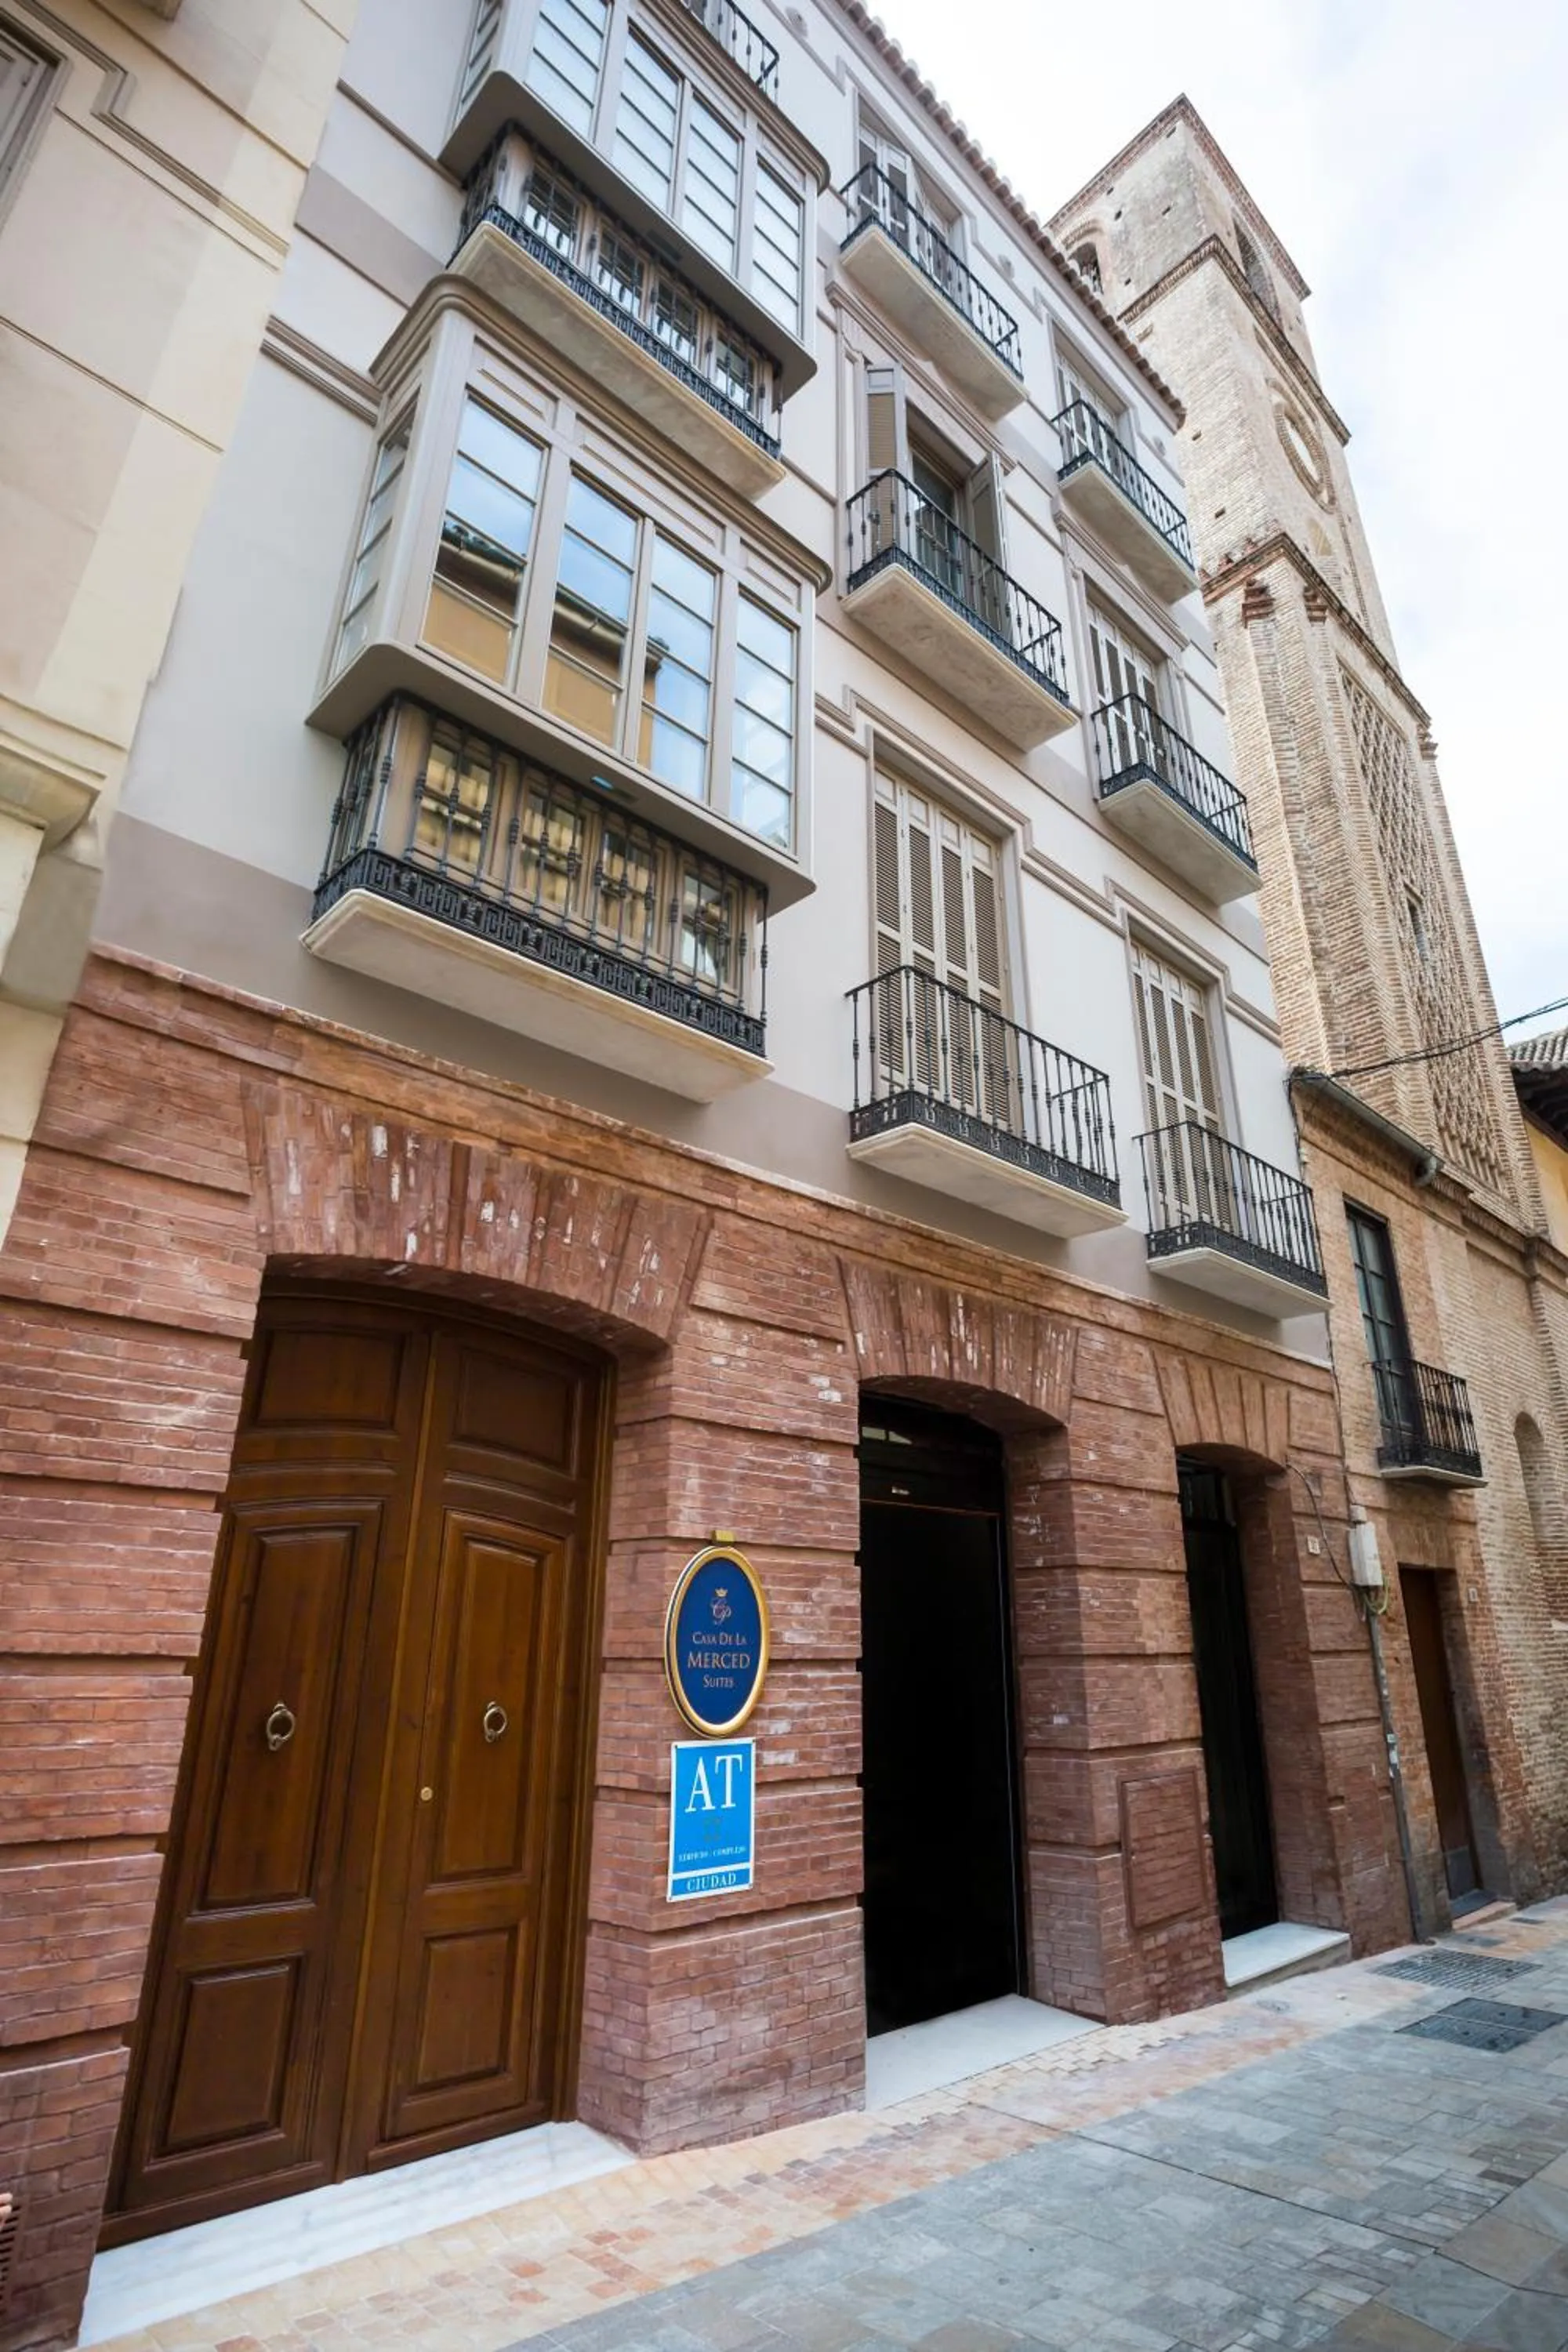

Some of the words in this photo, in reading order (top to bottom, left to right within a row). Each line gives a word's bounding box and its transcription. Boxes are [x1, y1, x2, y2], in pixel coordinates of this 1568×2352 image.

[688, 1650, 750, 1669] MERCED
[684, 1754, 743, 1813] AT
[687, 1872, 736, 1891] CIUDAD
